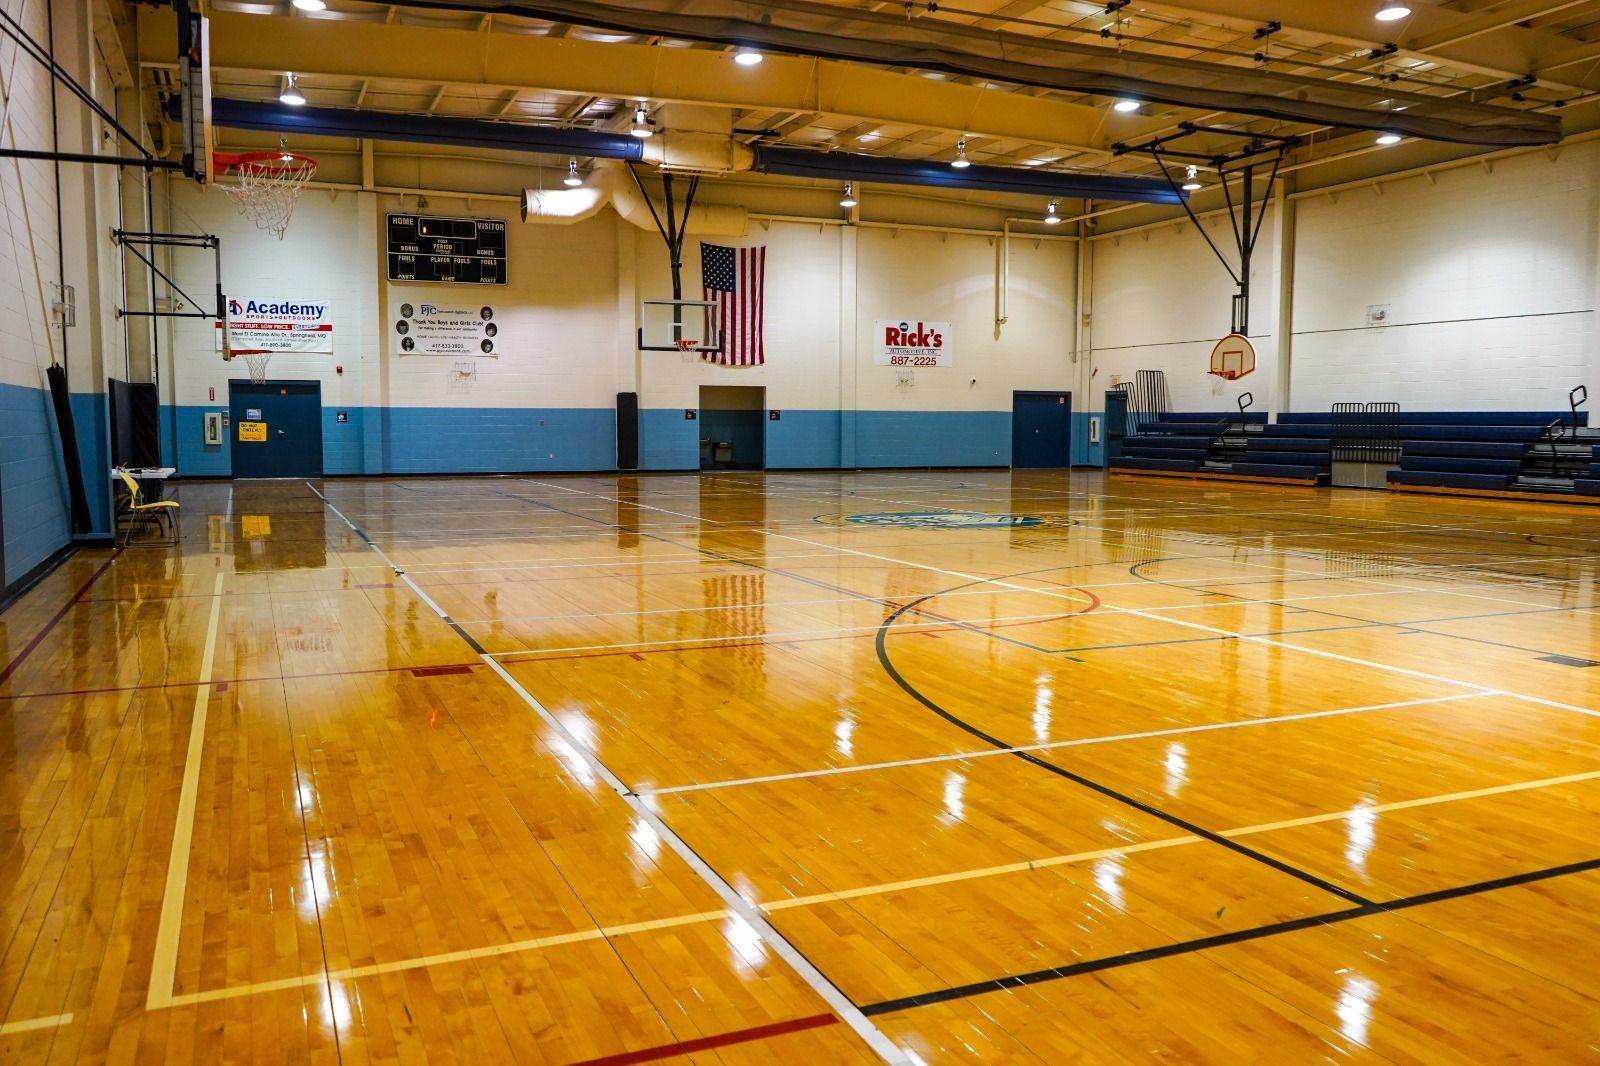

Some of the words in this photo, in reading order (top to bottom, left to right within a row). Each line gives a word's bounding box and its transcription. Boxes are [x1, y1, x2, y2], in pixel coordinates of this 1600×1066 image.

[392, 217, 414, 226] HOME
[477, 222, 504, 231] VISITOR
[246, 300, 324, 319] Academy
[421, 306, 437, 316] PJC
[886, 322, 942, 348] Rick's
[891, 356, 936, 366] 887-2225
